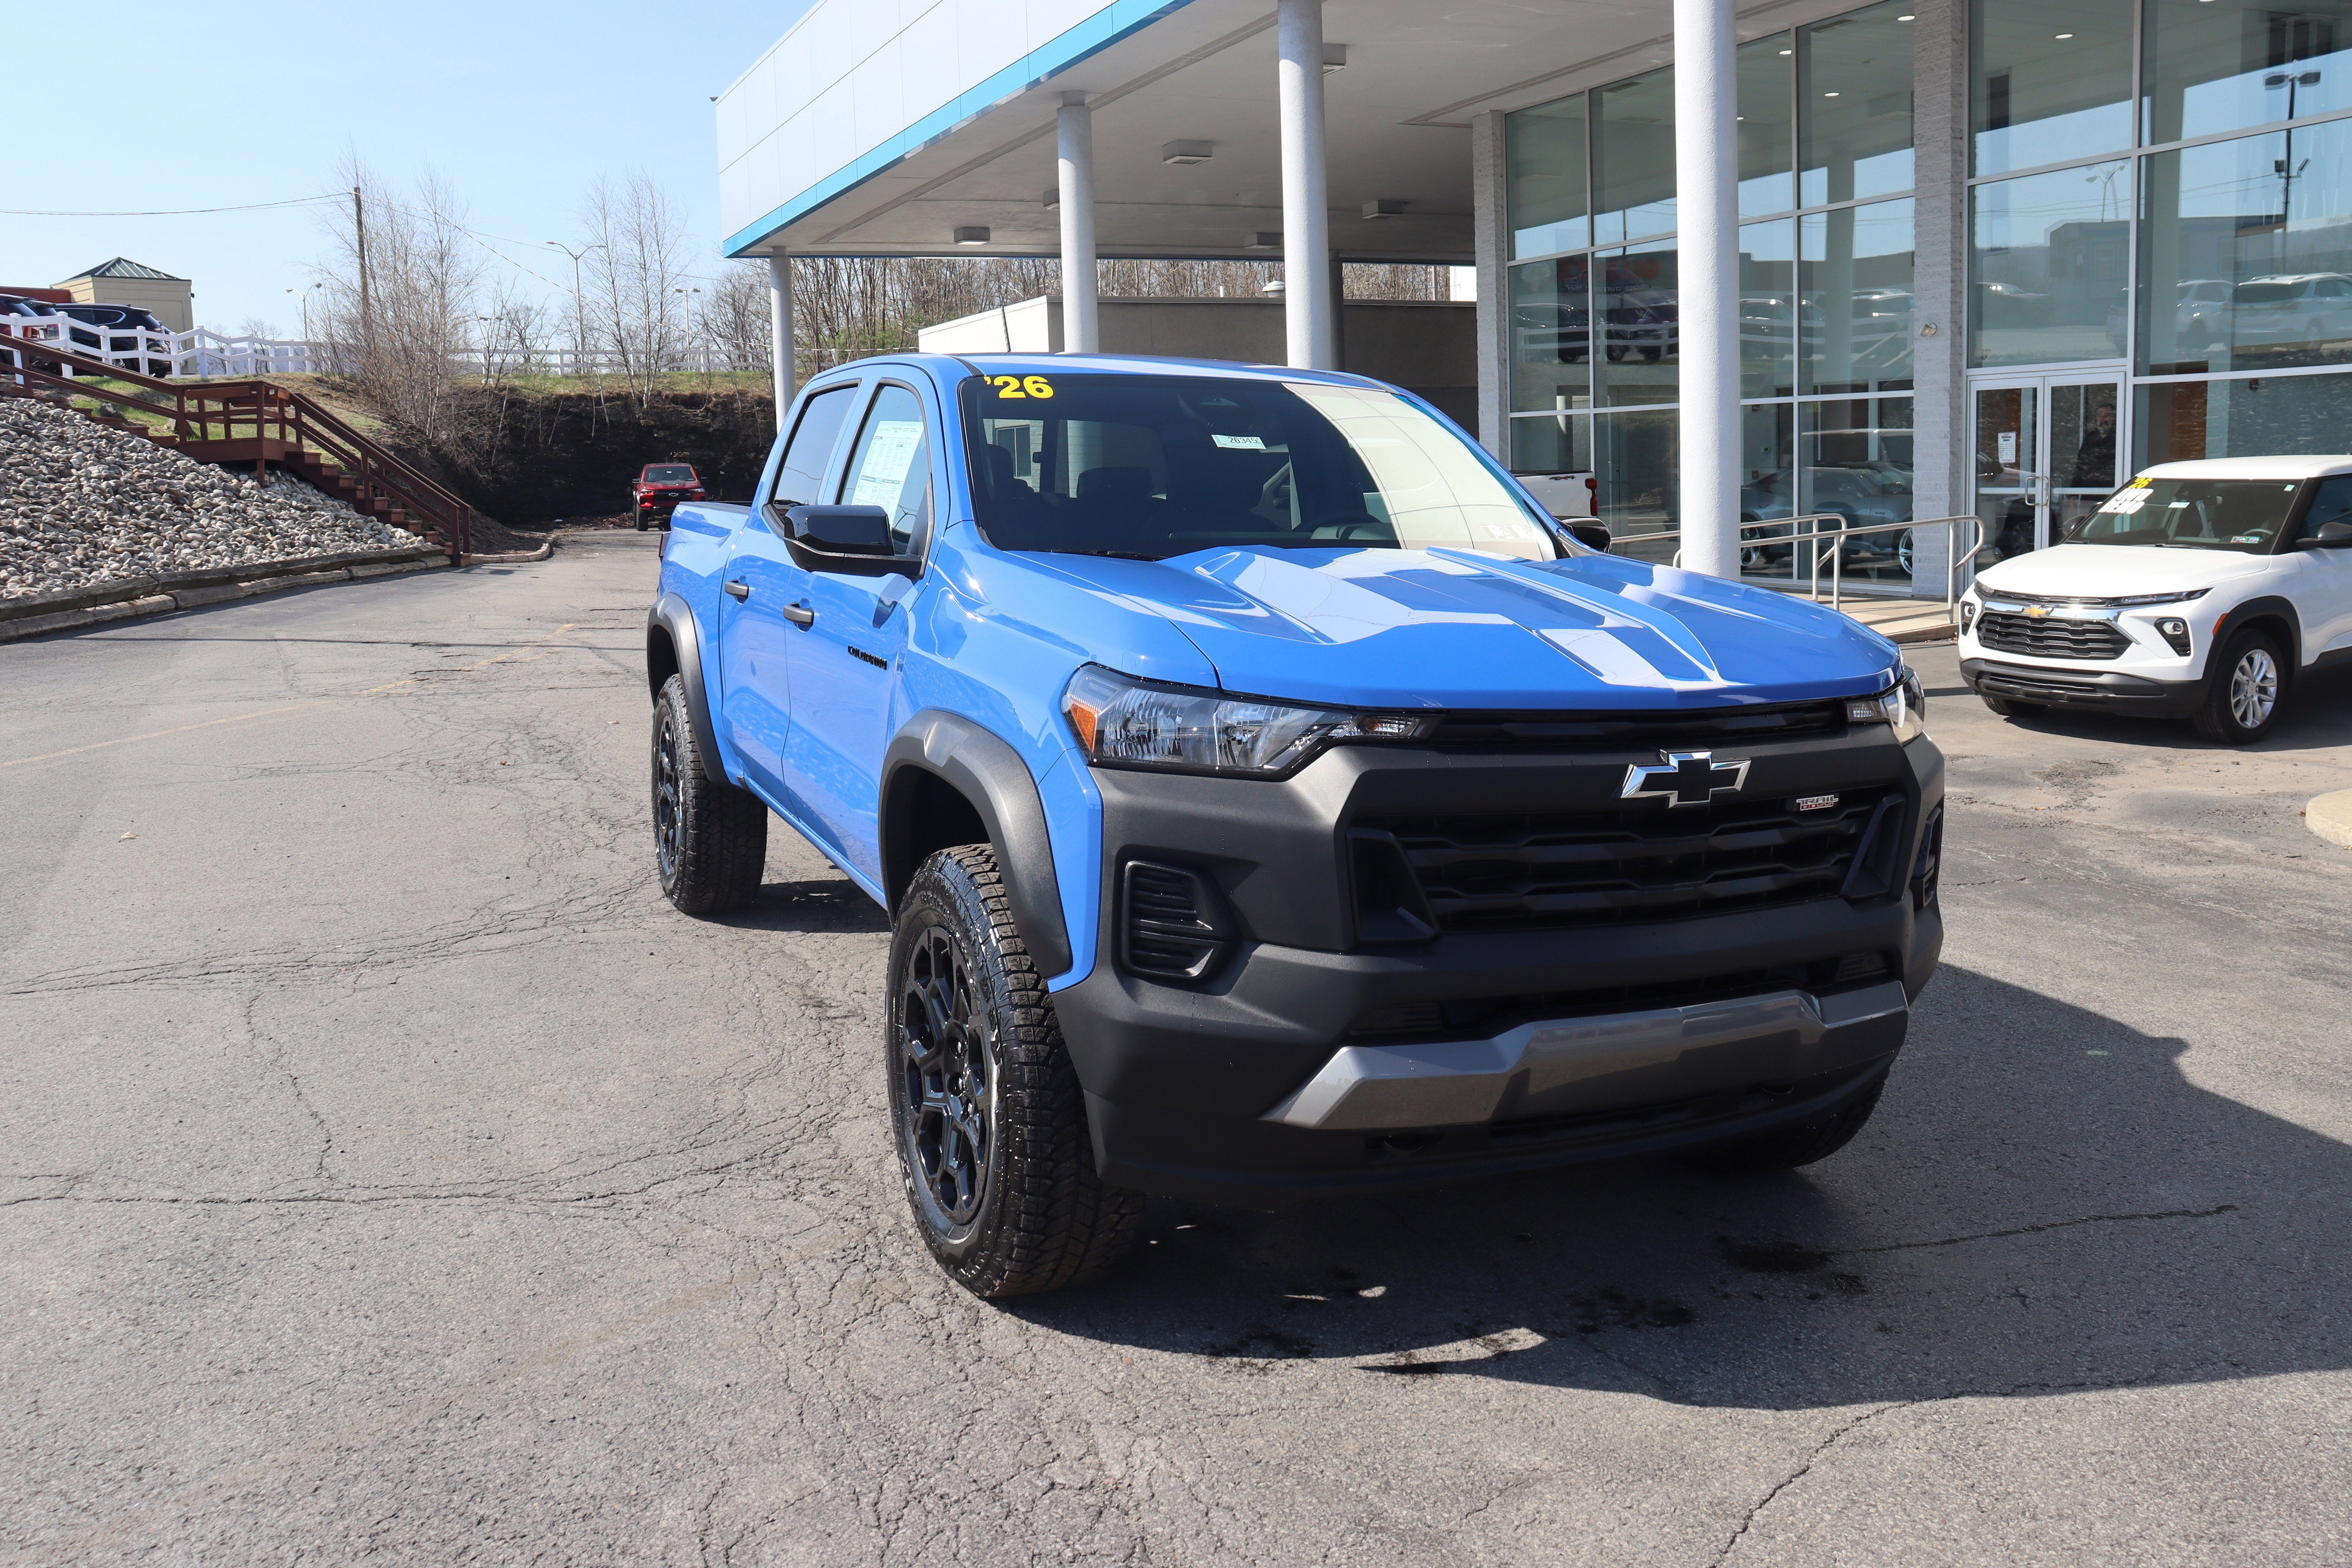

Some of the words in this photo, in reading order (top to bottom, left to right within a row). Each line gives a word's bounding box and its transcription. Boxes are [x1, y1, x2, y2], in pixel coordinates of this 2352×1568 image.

[984, 376, 1054, 399] '26
[2111, 488, 2154, 501] AWD
[2098, 500, 2145, 514] DEMO
[1796, 795, 1839, 805] TRAIL
[1800, 802, 1834, 811] BOSS
